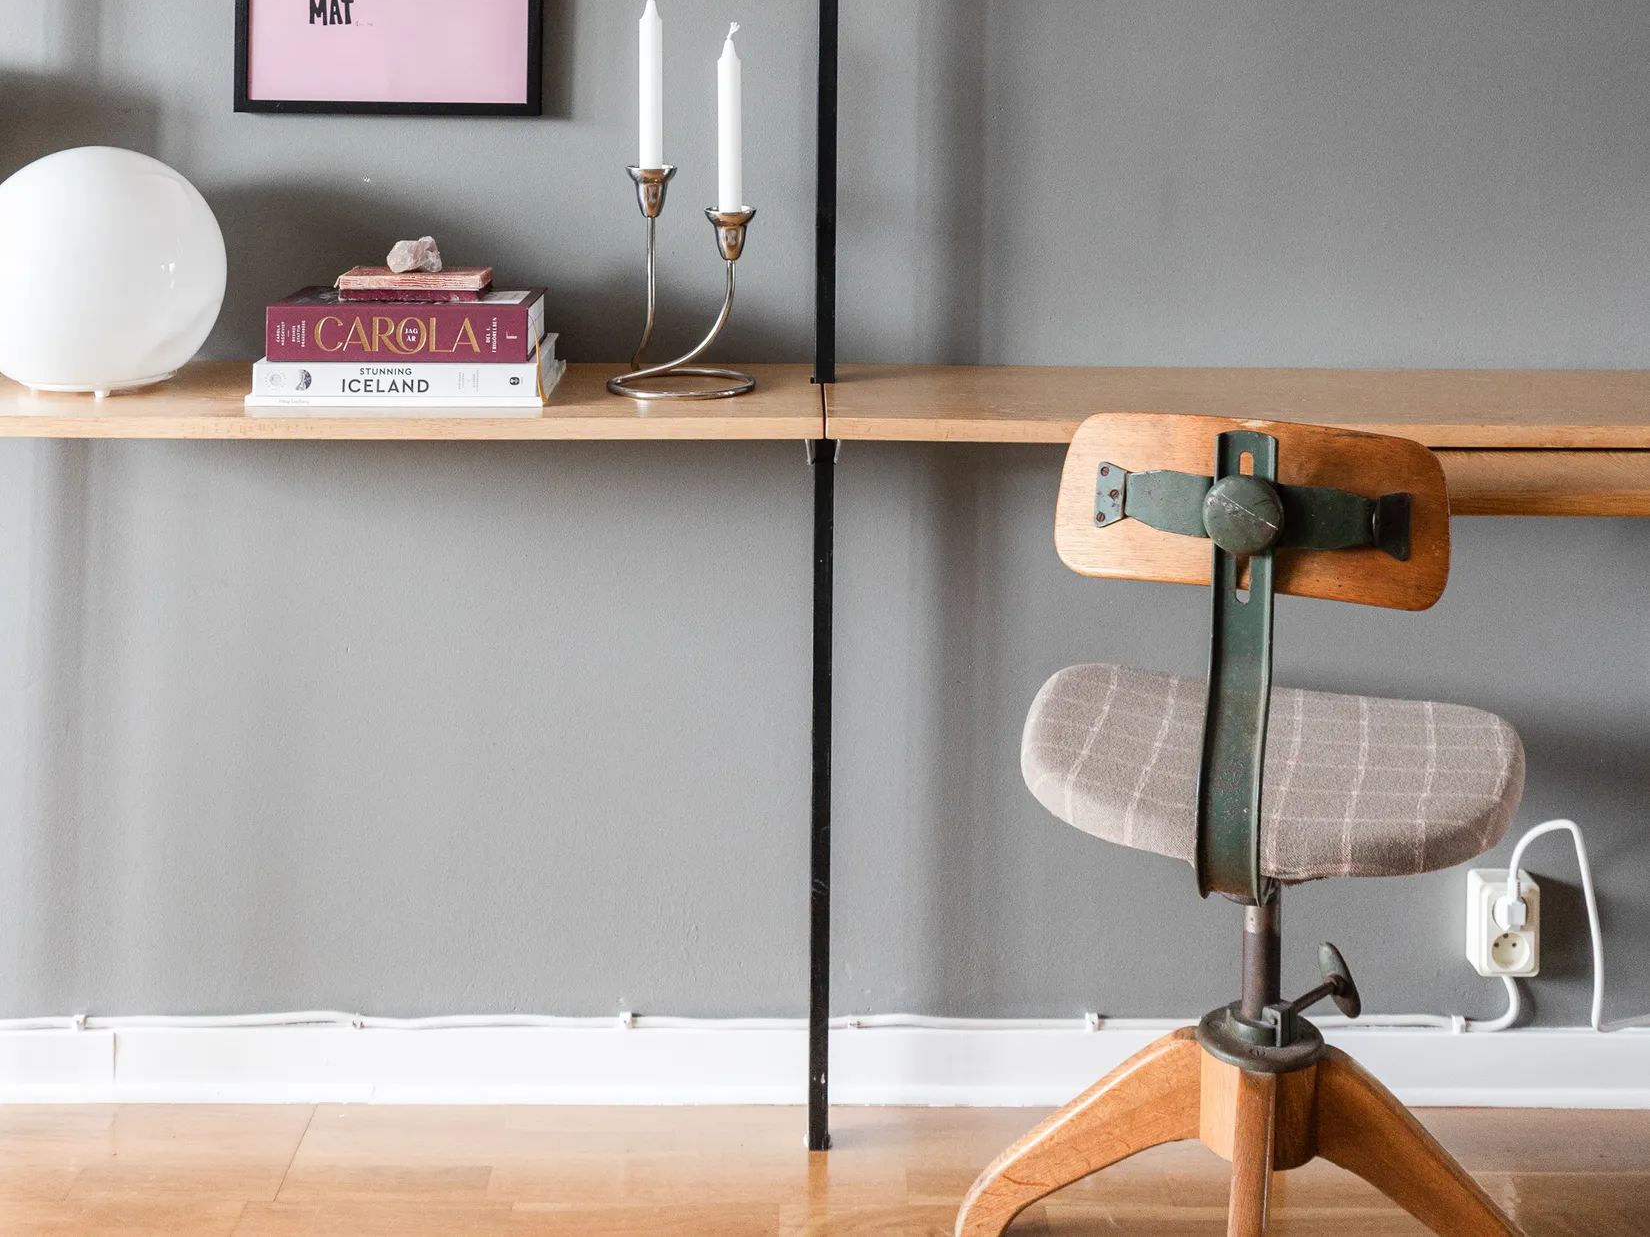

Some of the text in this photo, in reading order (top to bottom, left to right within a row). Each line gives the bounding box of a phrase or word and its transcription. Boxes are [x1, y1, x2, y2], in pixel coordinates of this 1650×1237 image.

[314, 316, 481, 354] CAROLA
[360, 368, 412, 376] STUNNING
[342, 379, 429, 393] ICELAND
